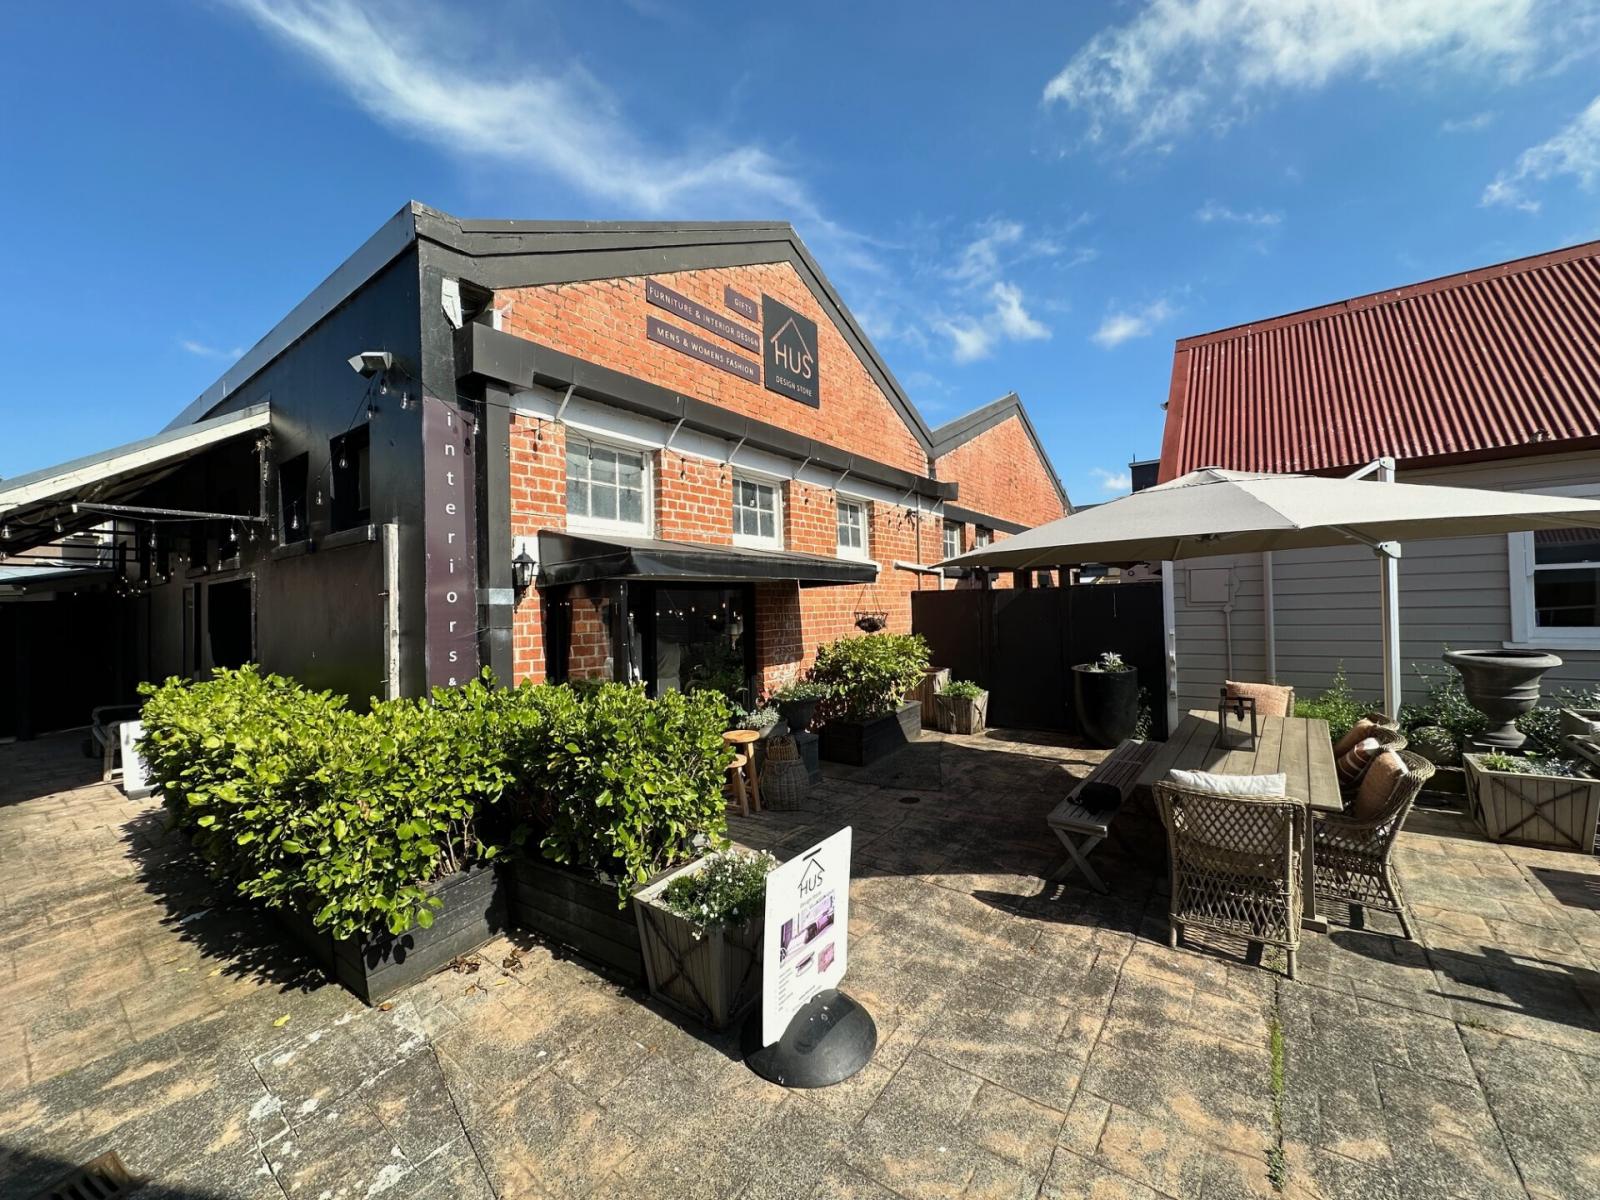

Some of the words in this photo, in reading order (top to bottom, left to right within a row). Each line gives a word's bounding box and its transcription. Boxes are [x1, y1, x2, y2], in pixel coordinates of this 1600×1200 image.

[649, 286, 693, 315] FURNITURE
[695, 310, 701, 320] &
[703, 313, 735, 335] INTERIOR
[737, 329, 759, 347] DESIGN
[734, 297, 752, 314] GIFTS
[656, 327, 680, 344] MENS
[683, 337, 689, 348] &
[691, 341, 724, 363] WOMENS
[726, 355, 754, 376] FASHION
[774, 340, 813, 379] HUS
[775, 375, 796, 390] DESIGN
[796, 384, 813, 397] STORE
[444, 412, 459, 663] interiors
[448, 676, 457, 686] &
[800, 873, 823, 898] HUS
